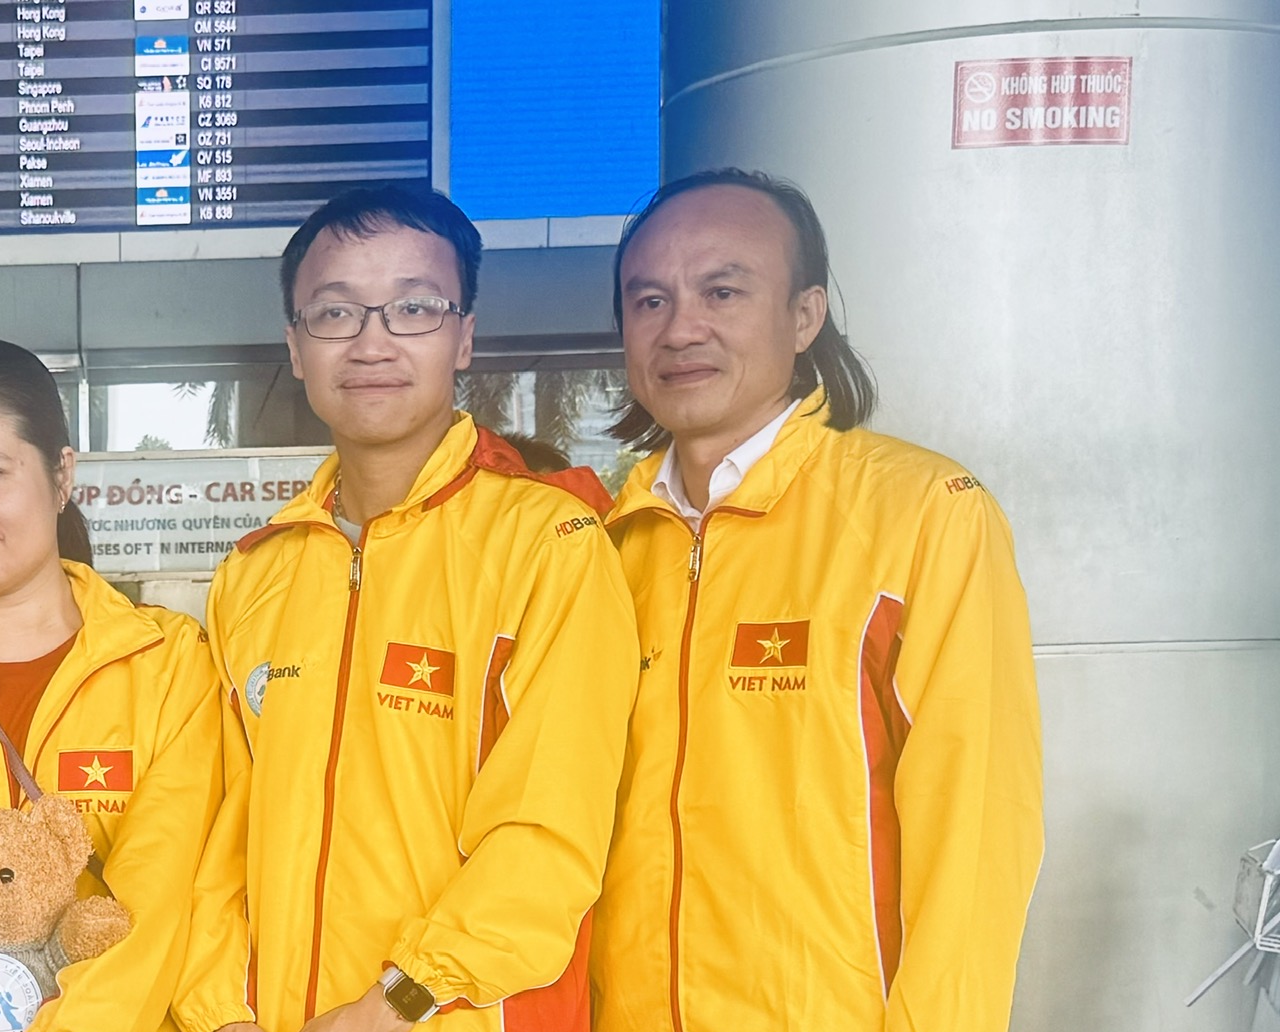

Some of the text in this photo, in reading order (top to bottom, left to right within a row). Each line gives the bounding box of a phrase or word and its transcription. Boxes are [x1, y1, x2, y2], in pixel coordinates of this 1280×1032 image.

[17, 7, 40, 22] Hong
[42, 6, 65, 22] Kong
[196, 1, 211, 15] QR
[17, 26, 40, 41] Hong
[42, 25, 65, 41] Kong
[17, 43, 44, 60] Taipei
[197, 38, 211, 52] VN
[215, 37, 231, 51] 571
[17, 62, 44, 79] Taipei
[201, 57, 211, 71] CI
[214, 56, 236, 71] 9571
[18, 80, 62, 97] Singapore
[196, 76, 212, 90] SQ
[1001, 68, 1123, 96] KHÔNG HÚT THUỐC
[19, 100, 49, 114] Phnom
[51, 97, 74, 113] Penh
[199, 94, 211, 108] K6
[215, 94, 232, 108] 812
[19, 118, 68, 135] Guangzhou
[198, 112, 212, 127] CZ
[214, 112, 237, 126] 3069
[962, 105, 1121, 132] NO SMOKING
[19, 136, 80, 151] Seoul-Incheon
[197, 131, 212, 146] OZ
[215, 131, 231, 145] 731
[20, 155, 47, 170] Pakse
[197, 150, 213, 165] QV
[215, 149, 232, 164] 515
[20, 173, 53, 188] Xiamen
[198, 169, 212, 183] MF
[20, 192, 53, 207] Xiamen
[198, 187, 212, 201] VN
[205, 481, 256, 502] CAR
[262, 479, 313, 501] SER
[175, 539, 236, 554] INTERNA
[729, 675, 806, 691] VIET NAM
[377, 692, 454, 720] VIET NAM
